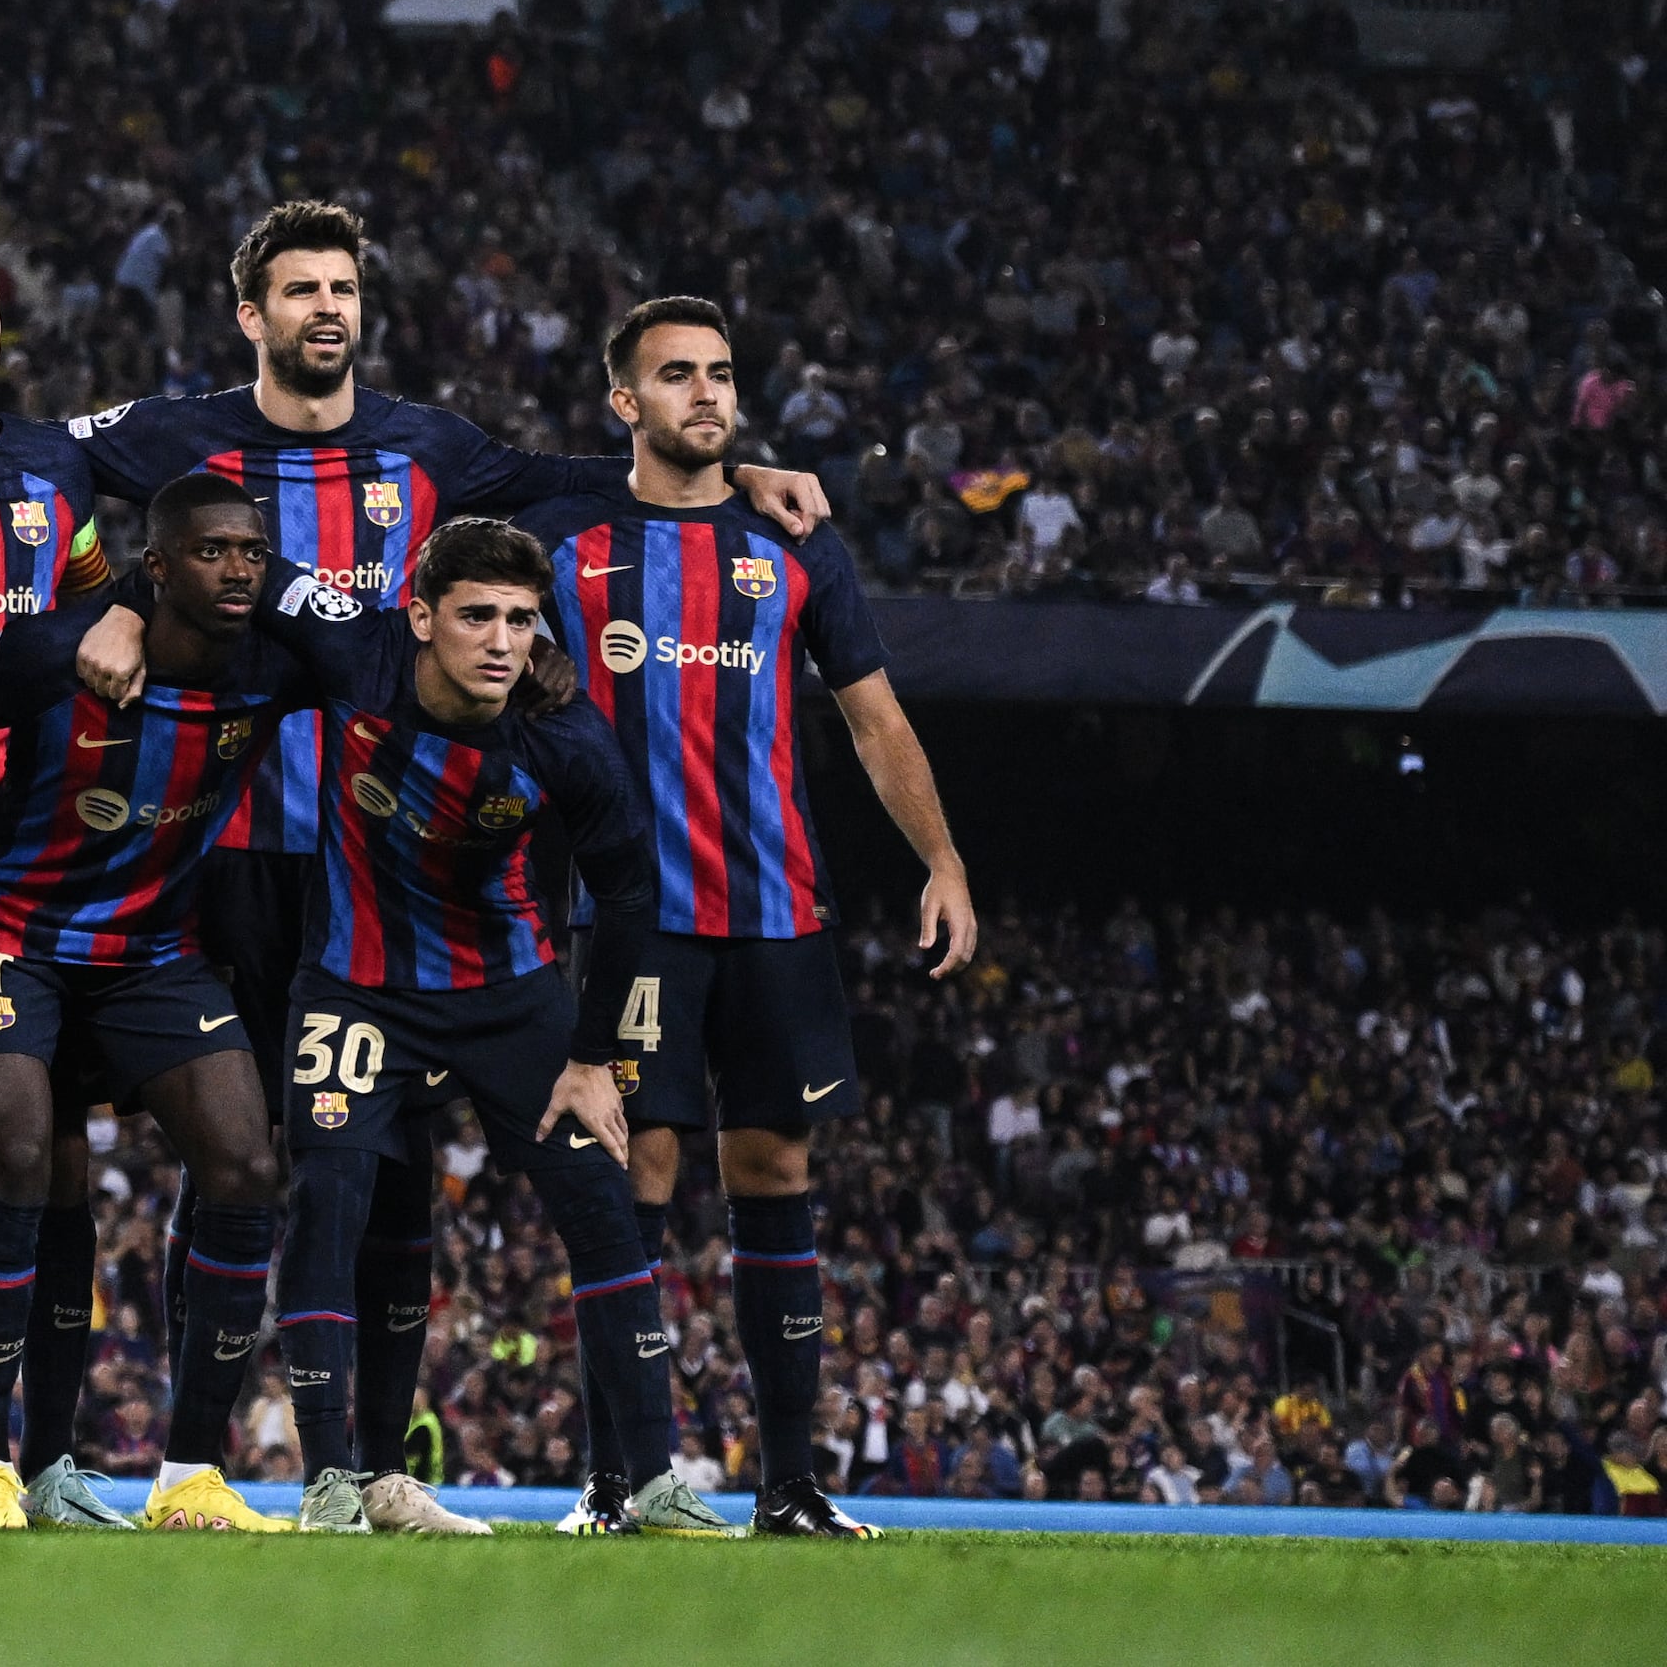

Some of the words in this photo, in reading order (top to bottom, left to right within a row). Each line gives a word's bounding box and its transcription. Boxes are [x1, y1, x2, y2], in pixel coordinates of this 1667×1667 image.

[655, 636, 766, 675] Spotify
[617, 976, 661, 1052] 4
[293, 1012, 386, 1094] 30
